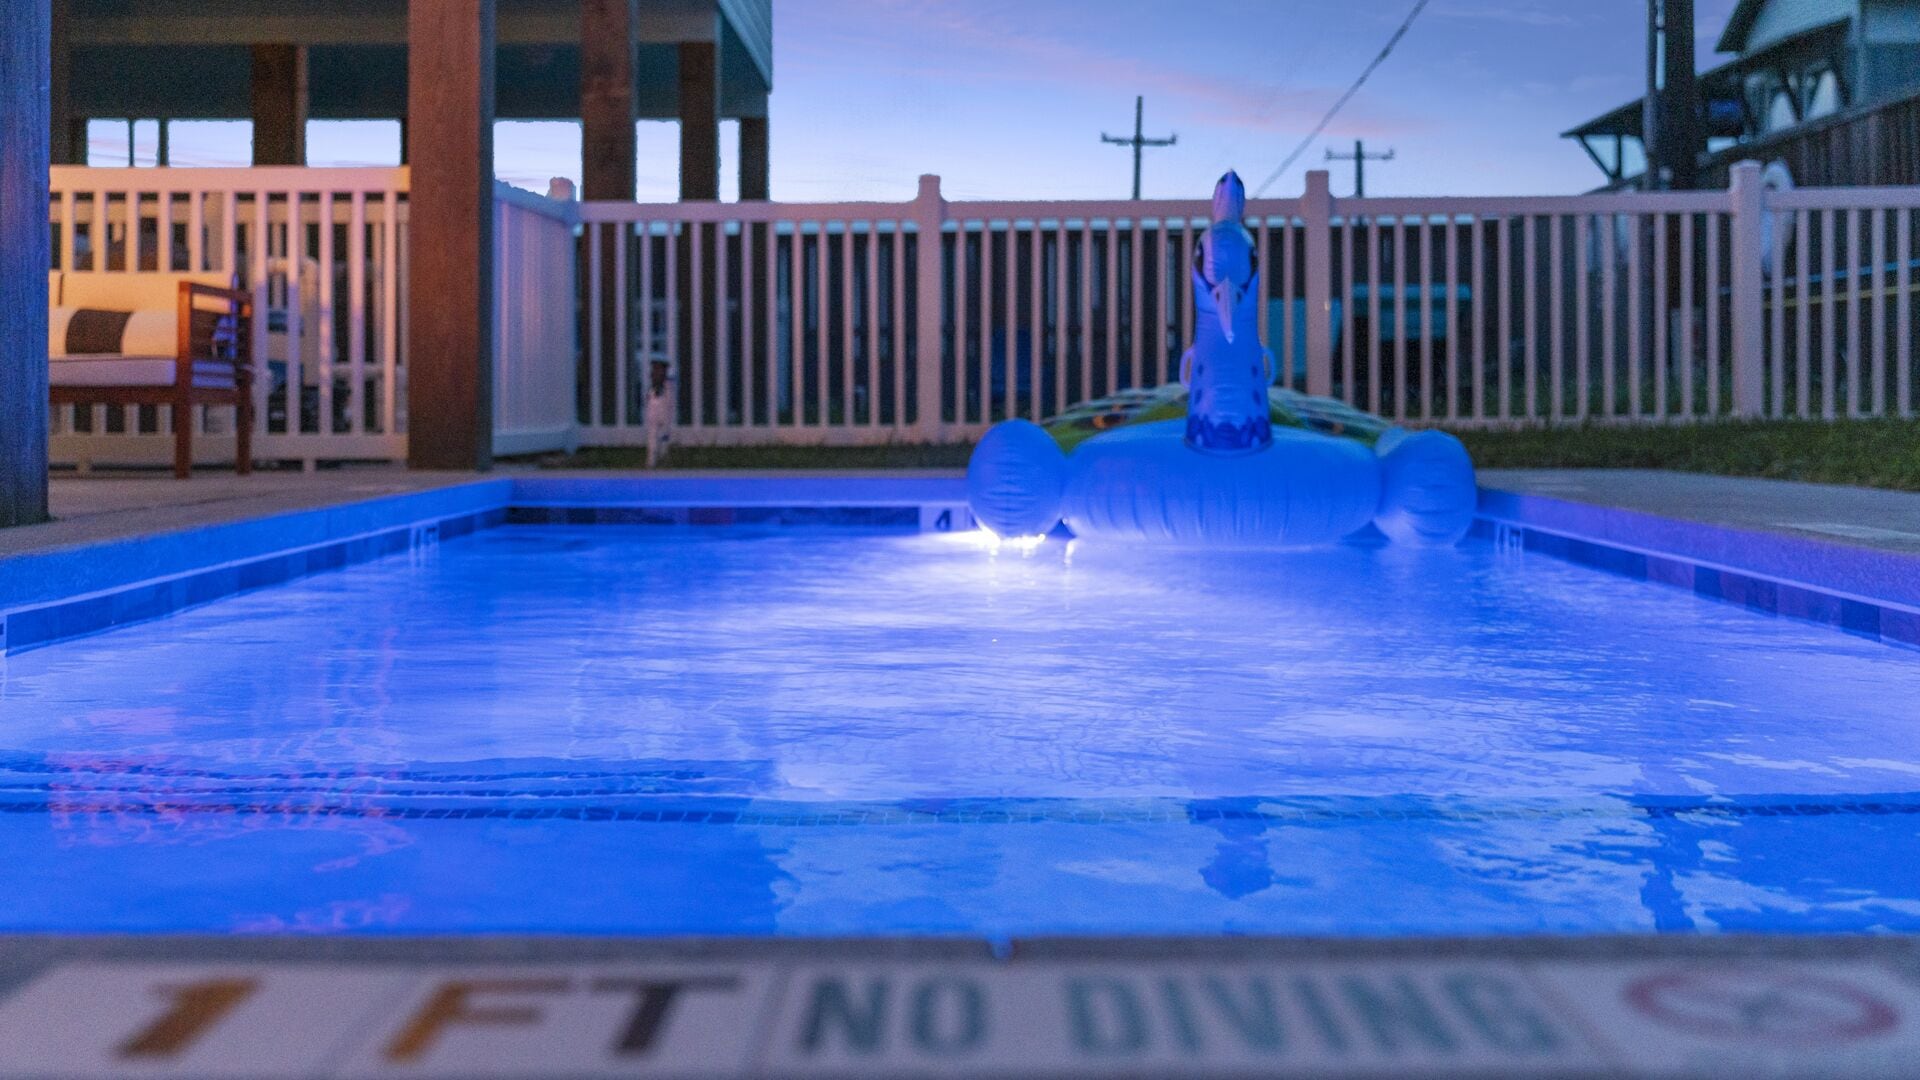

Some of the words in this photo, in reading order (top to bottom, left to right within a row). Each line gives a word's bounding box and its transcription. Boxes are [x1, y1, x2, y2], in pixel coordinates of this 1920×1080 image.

[113, 976, 264, 1060] 1
[380, 976, 744, 1061] FT
[798, 974, 990, 1054] NO
[1066, 973, 1558, 1056] DIVING
